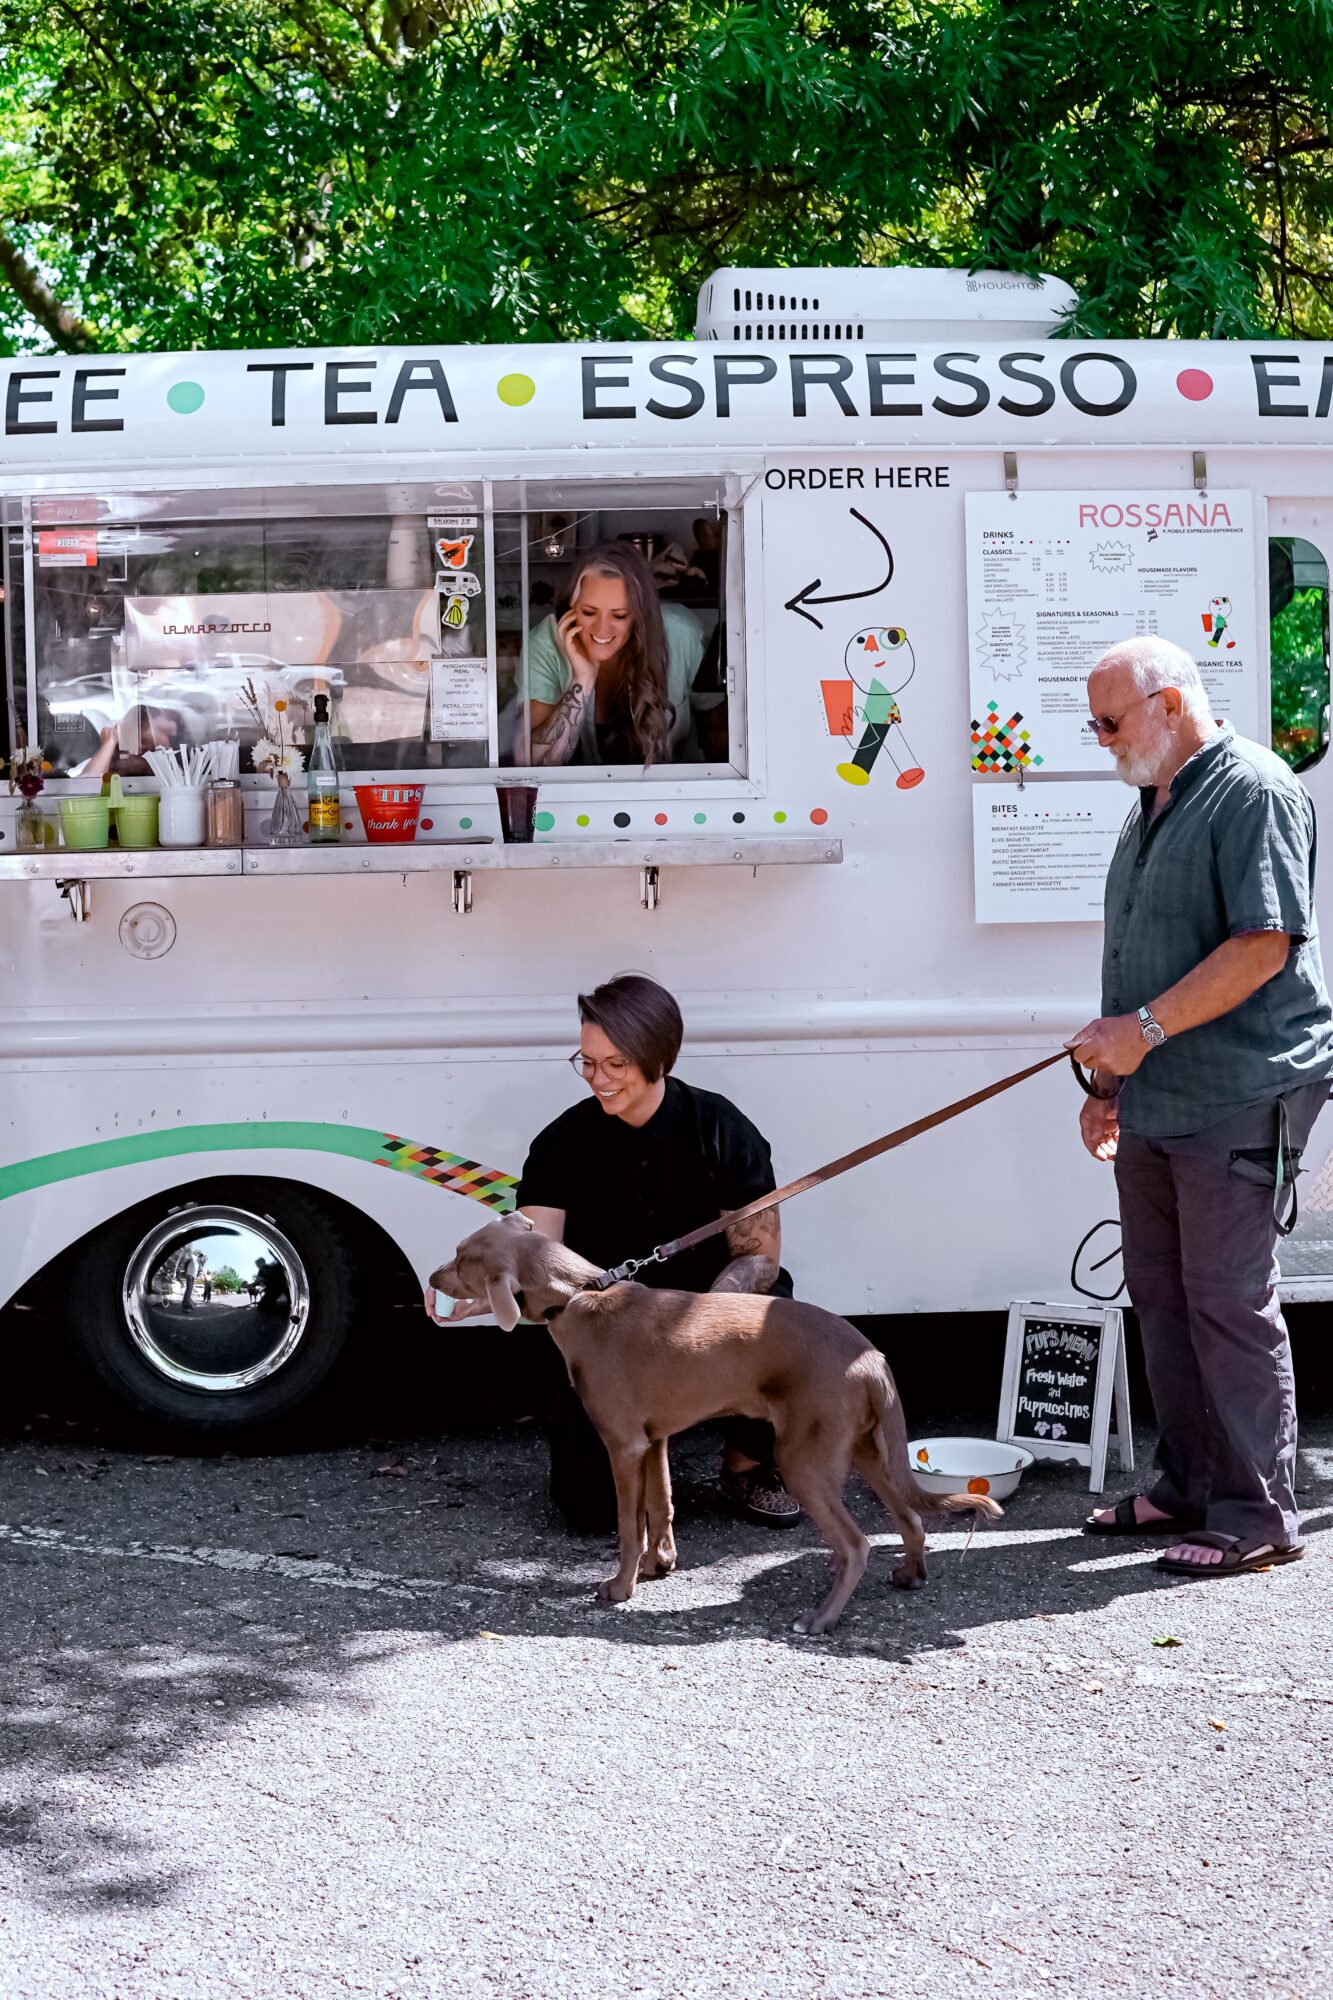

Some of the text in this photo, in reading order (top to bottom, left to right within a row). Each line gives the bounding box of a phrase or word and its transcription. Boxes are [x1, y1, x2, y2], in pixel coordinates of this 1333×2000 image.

[978, 281, 1044, 290] HOUGHTON
[246, 359, 459, 427] TEA
[582, 352, 1137, 420] ESPRESSO
[765, 466, 950, 490] ORDER HERE
[1079, 503, 1231, 528] ROSSANA
[380, 788, 421, 802] TIPS
[368, 818, 399, 830] thank
[1026, 1329, 1098, 1361] PUPS MENU
[1026, 1368, 1087, 1387] Fresh Water
[1048, 1387, 1060, 1398] and
[1018, 1396, 1090, 1419] Puppuccinos
